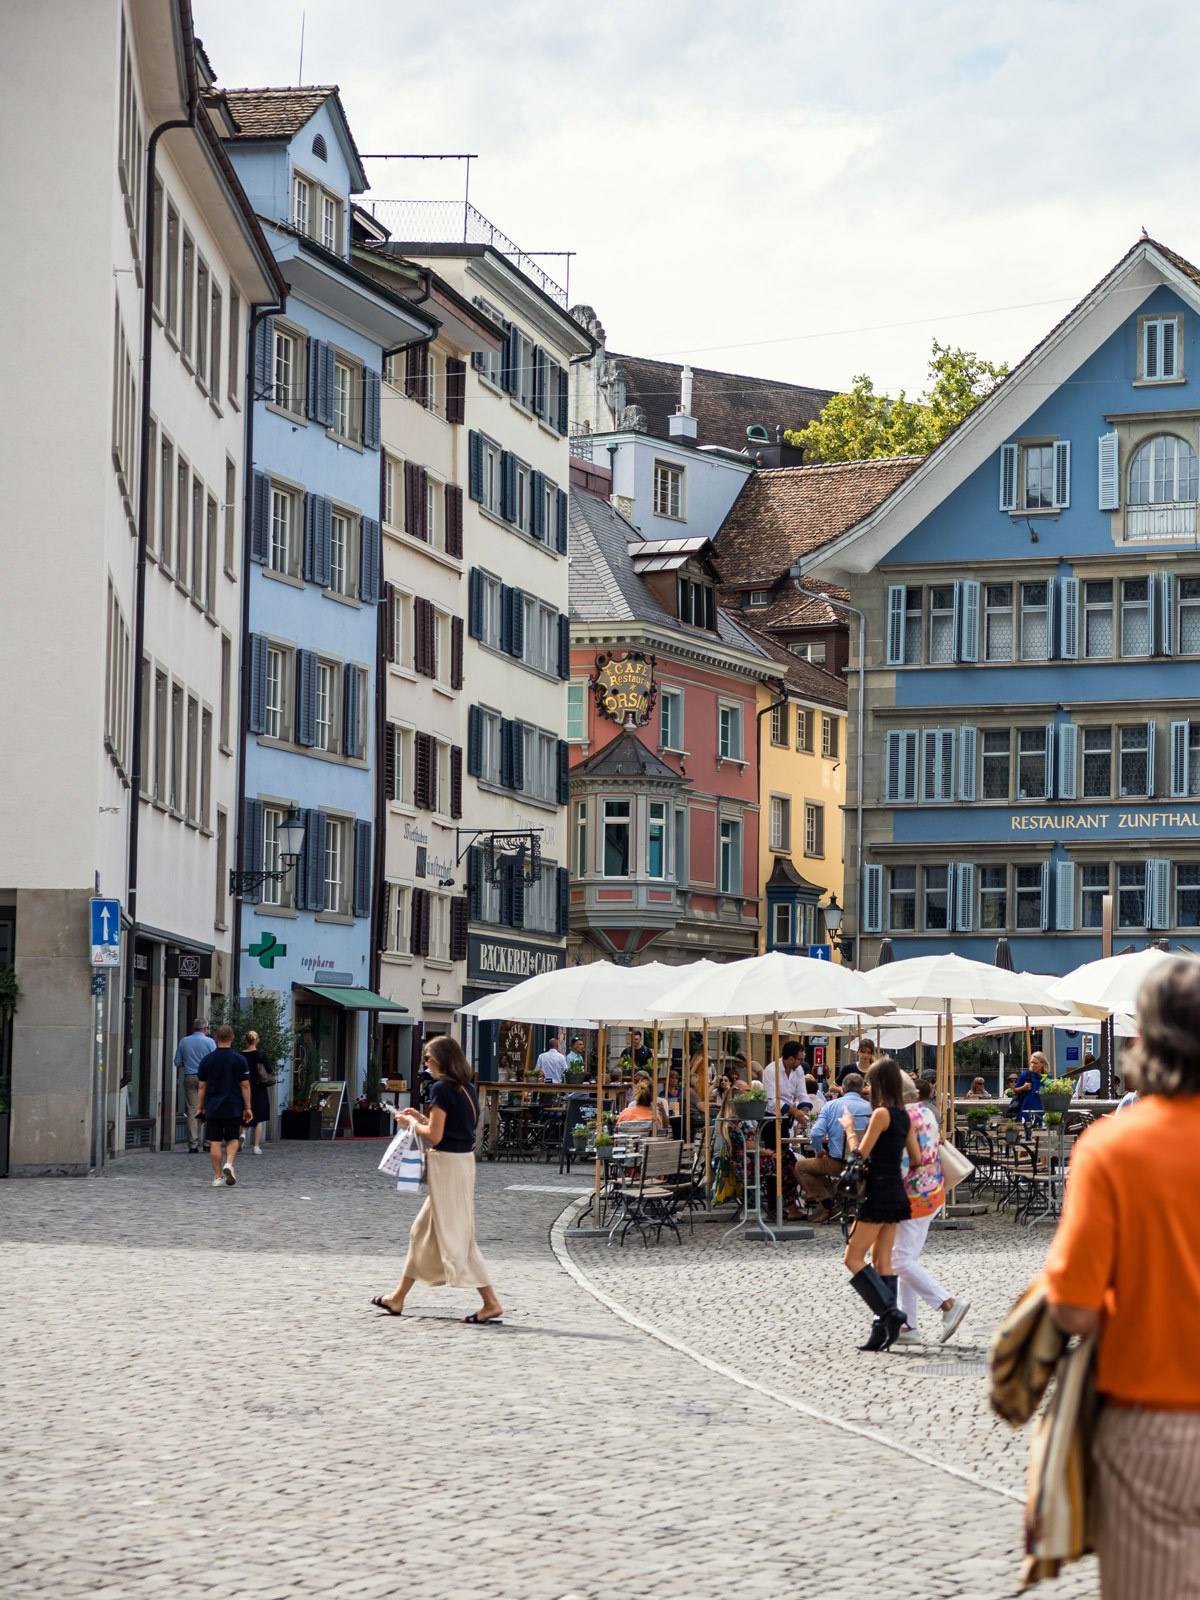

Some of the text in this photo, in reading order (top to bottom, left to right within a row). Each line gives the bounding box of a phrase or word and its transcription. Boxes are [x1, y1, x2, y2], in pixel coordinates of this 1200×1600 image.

[1011, 814, 1110, 830] RESTAURANT
[301, 955, 335, 971] toppharm
[480, 943, 531, 976] BÄCKEREI
